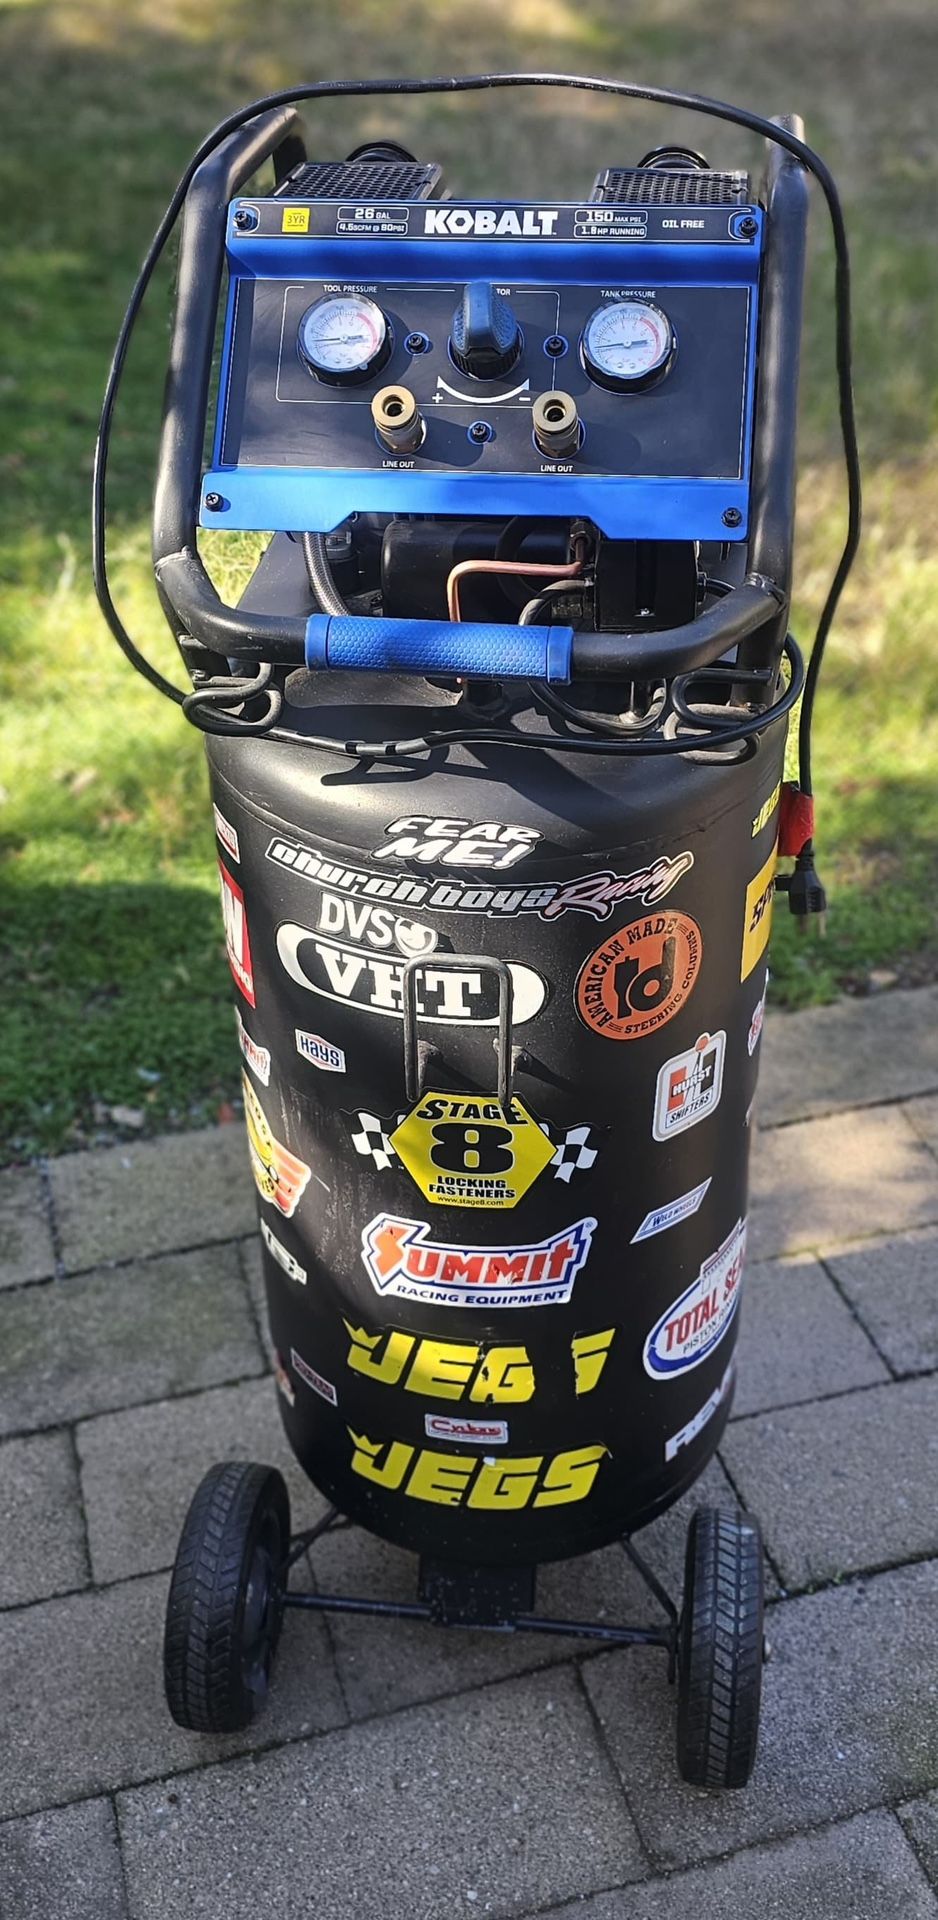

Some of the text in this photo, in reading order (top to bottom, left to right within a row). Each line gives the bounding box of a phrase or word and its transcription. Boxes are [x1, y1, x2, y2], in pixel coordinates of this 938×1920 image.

[355, 208, 375, 219] 26
[424, 210, 559, 235] KOBALT
[585, 210, 613, 222] 150
[662, 219, 705, 229] OIL FREE
[609, 228, 645, 236] RUNNING
[343, 285, 378, 293] PRESSURE
[382, 460, 398, 468] LINE
[557, 465, 573, 473] OUT
[387, 816, 541, 843] FEAR
[372, 837, 530, 867] ME!
[271, 843, 428, 903] church
[429, 885, 558, 912] boys
[319, 893, 395, 948] DVS
[584, 918, 677, 1028] AMERICAN MADE
[682, 930, 698, 989] COLUMNS
[315, 943, 482, 1017] VHT
[624, 993, 682, 1034] STEERING
[672, 1065, 712, 1097] HURST
[417, 1098, 528, 1125] STAGE
[670, 1093, 711, 1123] SHIFTERS
[430, 1122, 514, 1175] 8
[429, 1184, 515, 1199] FASTENERS
[437, 1175, 506, 1188] LOCKING
[437, 1195, 504, 1206] www.stage8.com
[396, 1285, 568, 1305] RACING EQUIPMENT
[664, 1287, 720, 1352] TOTAL
[350, 1442, 608, 1511] JEGS
